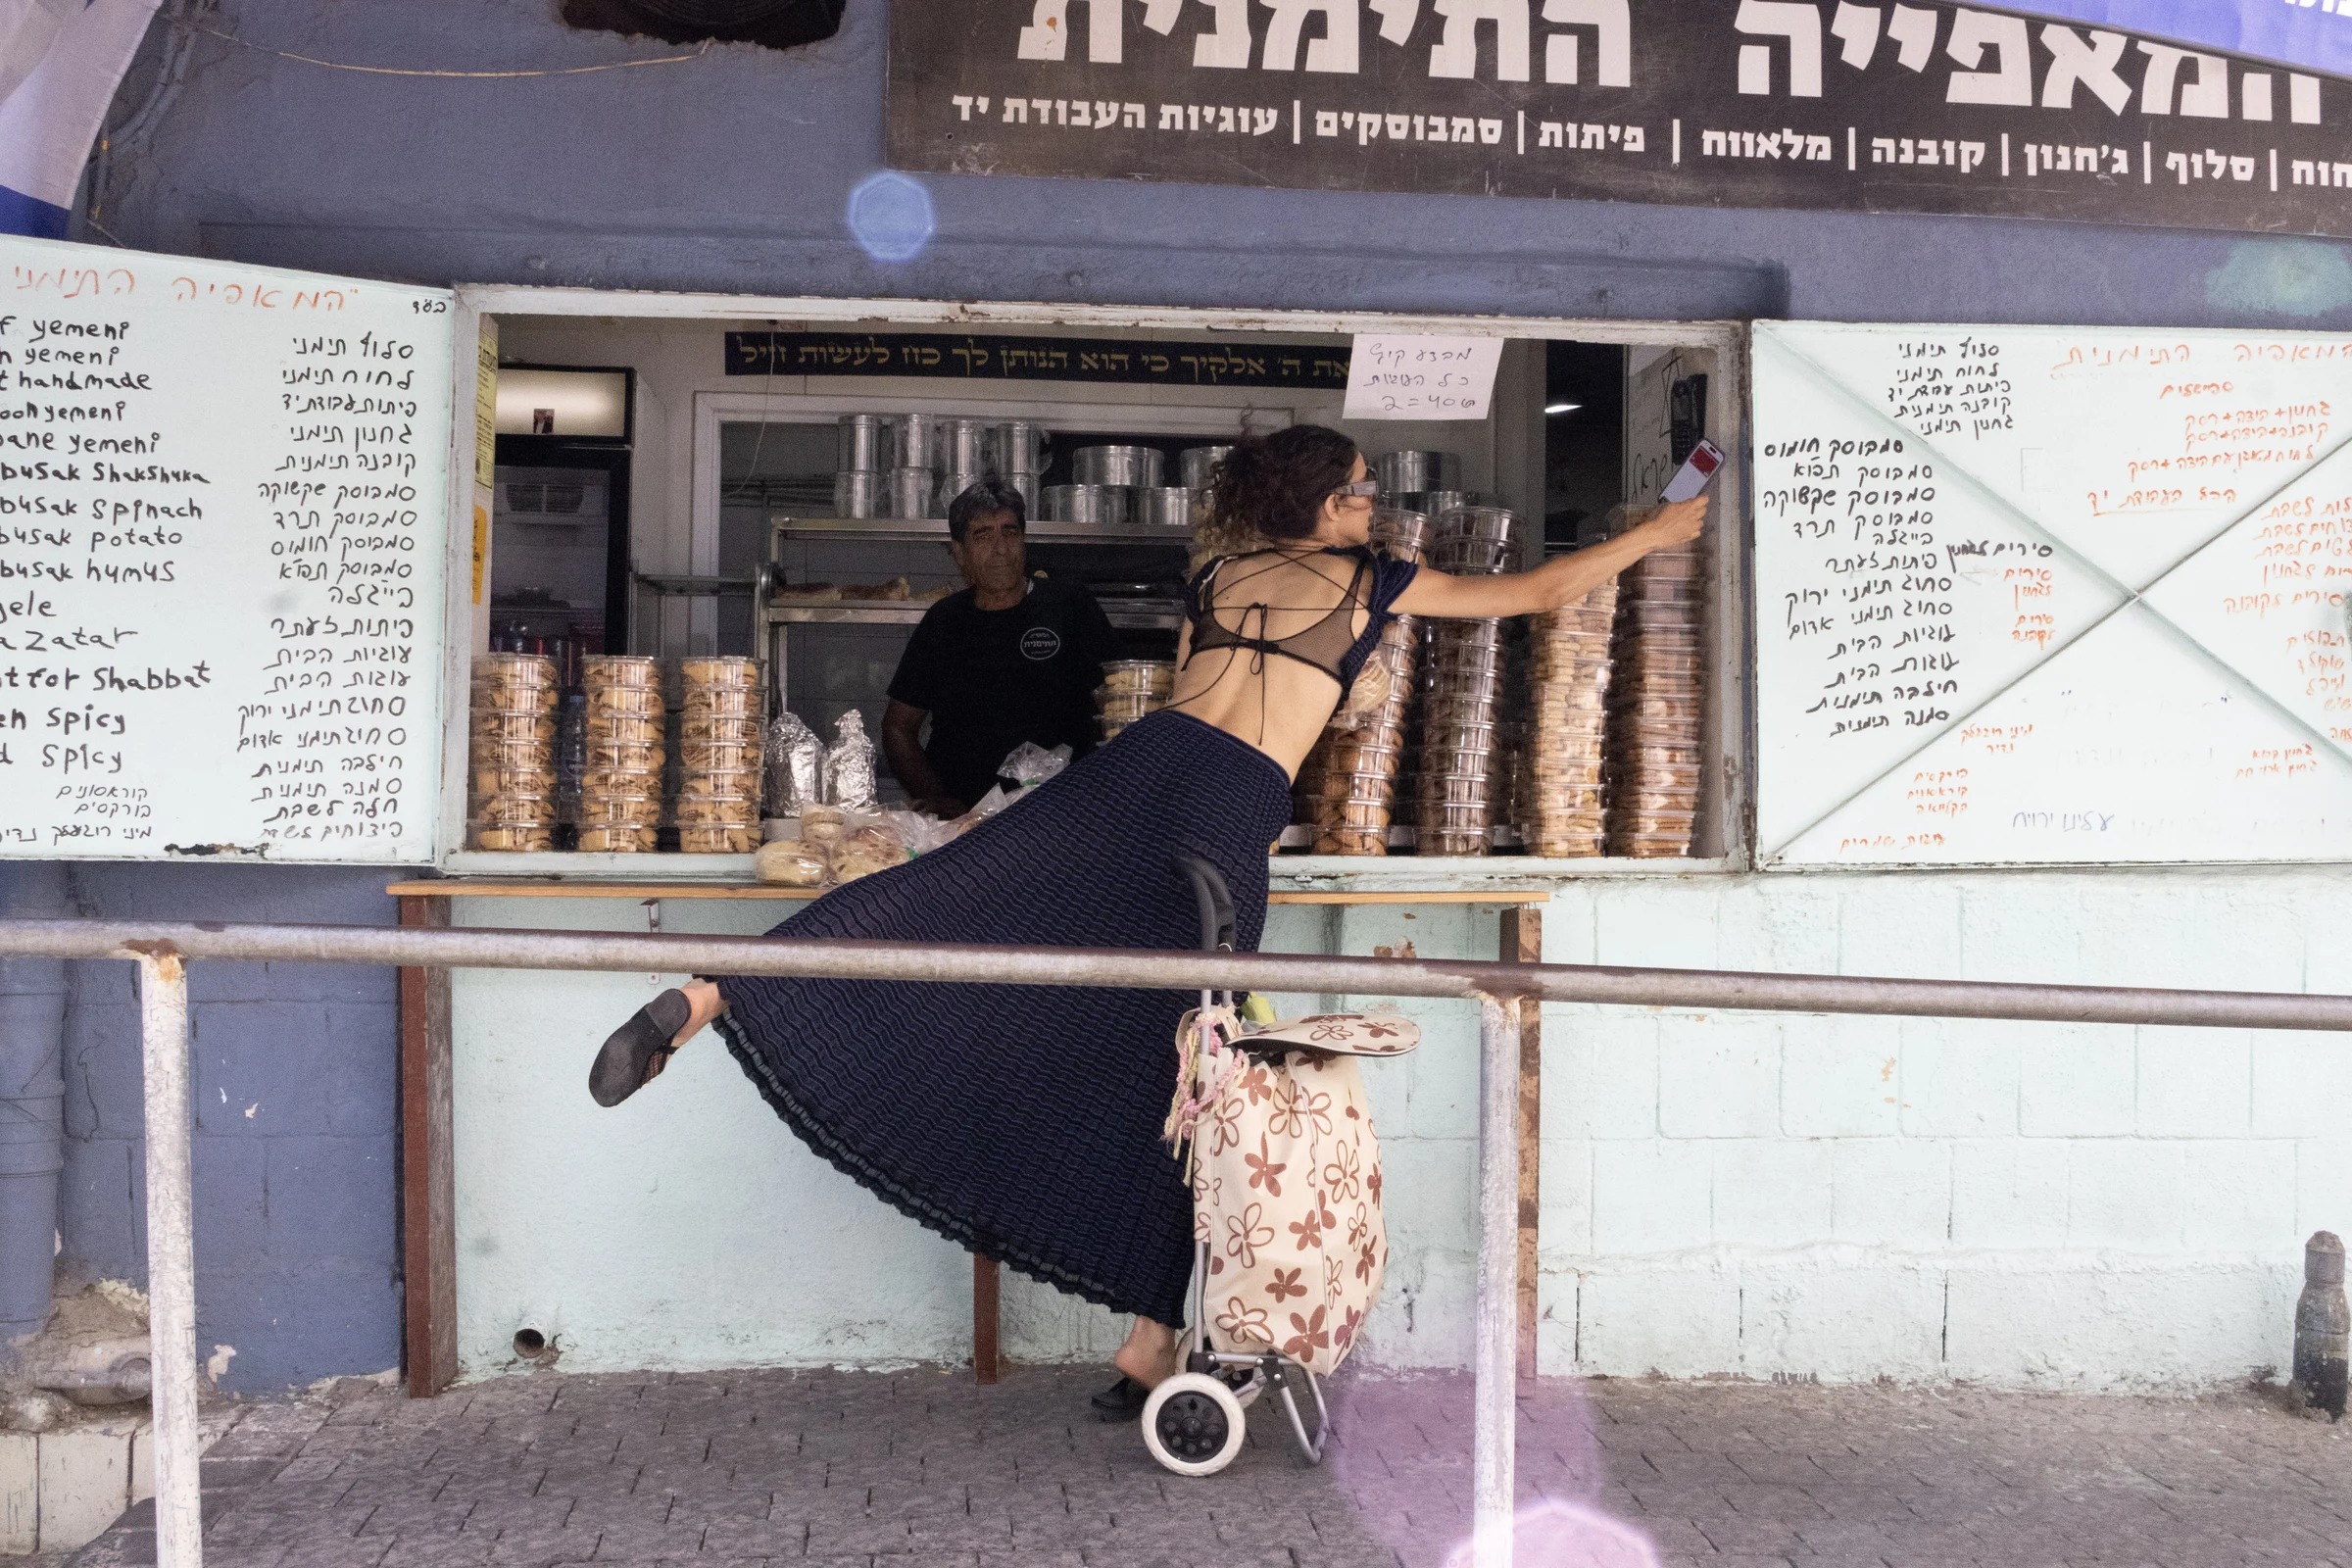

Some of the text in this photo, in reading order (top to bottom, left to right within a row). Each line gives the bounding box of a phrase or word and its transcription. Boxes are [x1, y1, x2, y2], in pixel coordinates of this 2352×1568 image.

[1017, 0, 1631, 88] התימנית
[952, 94, 990, 122] יד
[1002, 97, 1147, 129] העבודת
[1158, 104, 1278, 135] עוגיות
[1315, 110, 1502, 145] סמבוסקים
[1539, 121, 1645, 152] פיתות
[1701, 128, 1832, 161] מלאווח
[1872, 137, 1985, 173] קובנה
[2166, 149, 2256, 185] סלוף
[28, 319, 129, 343] yemeni
[25, 346, 120, 366] yemeni
[293, 331, 415, 359] סלוף תימני
[798, 336, 891, 367] לעשות
[951, 337, 989, 376] לך
[1415, 347, 1472, 363] מבצע
[1898, 343, 1946, 358] תימני
[2052, 344, 2191, 369] התימנית
[1000, 345, 1068, 376] הנותן
[1080, 352, 1129, 371] הוא
[1141, 354, 1169, 372] כי
[1180, 347, 1266, 383] אלקיך
[1896, 363, 2000, 383] לחוח תימני
[19, 370, 152, 390] handmade
[282, 368, 415, 390] לחוח תימני
[1438, 372, 1469, 387] כל
[1959, 380, 2011, 396] פיתות
[44, 401, 125, 422] yemeni
[1893, 397, 2011, 417] קובנה תימנית
[290, 423, 413, 453] גחנון תימני
[1920, 419, 1961, 436] תימני
[0, 431, 161, 455] ane yemeni
[1763, 437, 1904, 463] סמבוסק חומוס
[274, 454, 416, 477] קובנה תימנית
[1857, 464, 1934, 487] סמבוסק
[258, 481, 416, 509] סמבוסק שקשוקה
[1847, 487, 1936, 516] סמבוסק
[273, 510, 417, 539] סמבוסק תרד
[1792, 512, 1934, 540] סמבוסק תרד
[91, 526, 182, 553] potato
[271, 535, 415, 563] סמבוסק חומוס
[337, 560, 412, 584] סמבוסק
[1785, 573, 1953, 627] סחוג תימני ירוק
[1903, 599, 1953, 615] סחוג
[1851, 604, 1893, 625] תימני
[341, 618, 414, 638] פיתות
[1828, 624, 1956, 660] עוגיות הבית
[263, 646, 412, 670] עוגיות הבית
[27, 667, 80, 690] for
[264, 669, 412, 695] עוגות הבית
[1824, 662, 1880, 689] הבית
[1806, 689, 1883, 713] תימנית
[238, 696, 406, 735] סחוג תימני ירוק
[297, 731, 341, 748] תימני
[251, 755, 403, 778] חילבה תימנית
[251, 778, 402, 802] סמנה תימנית
[263, 798, 398, 823] חלה לשבת
[122, 826, 152, 840] מיני
